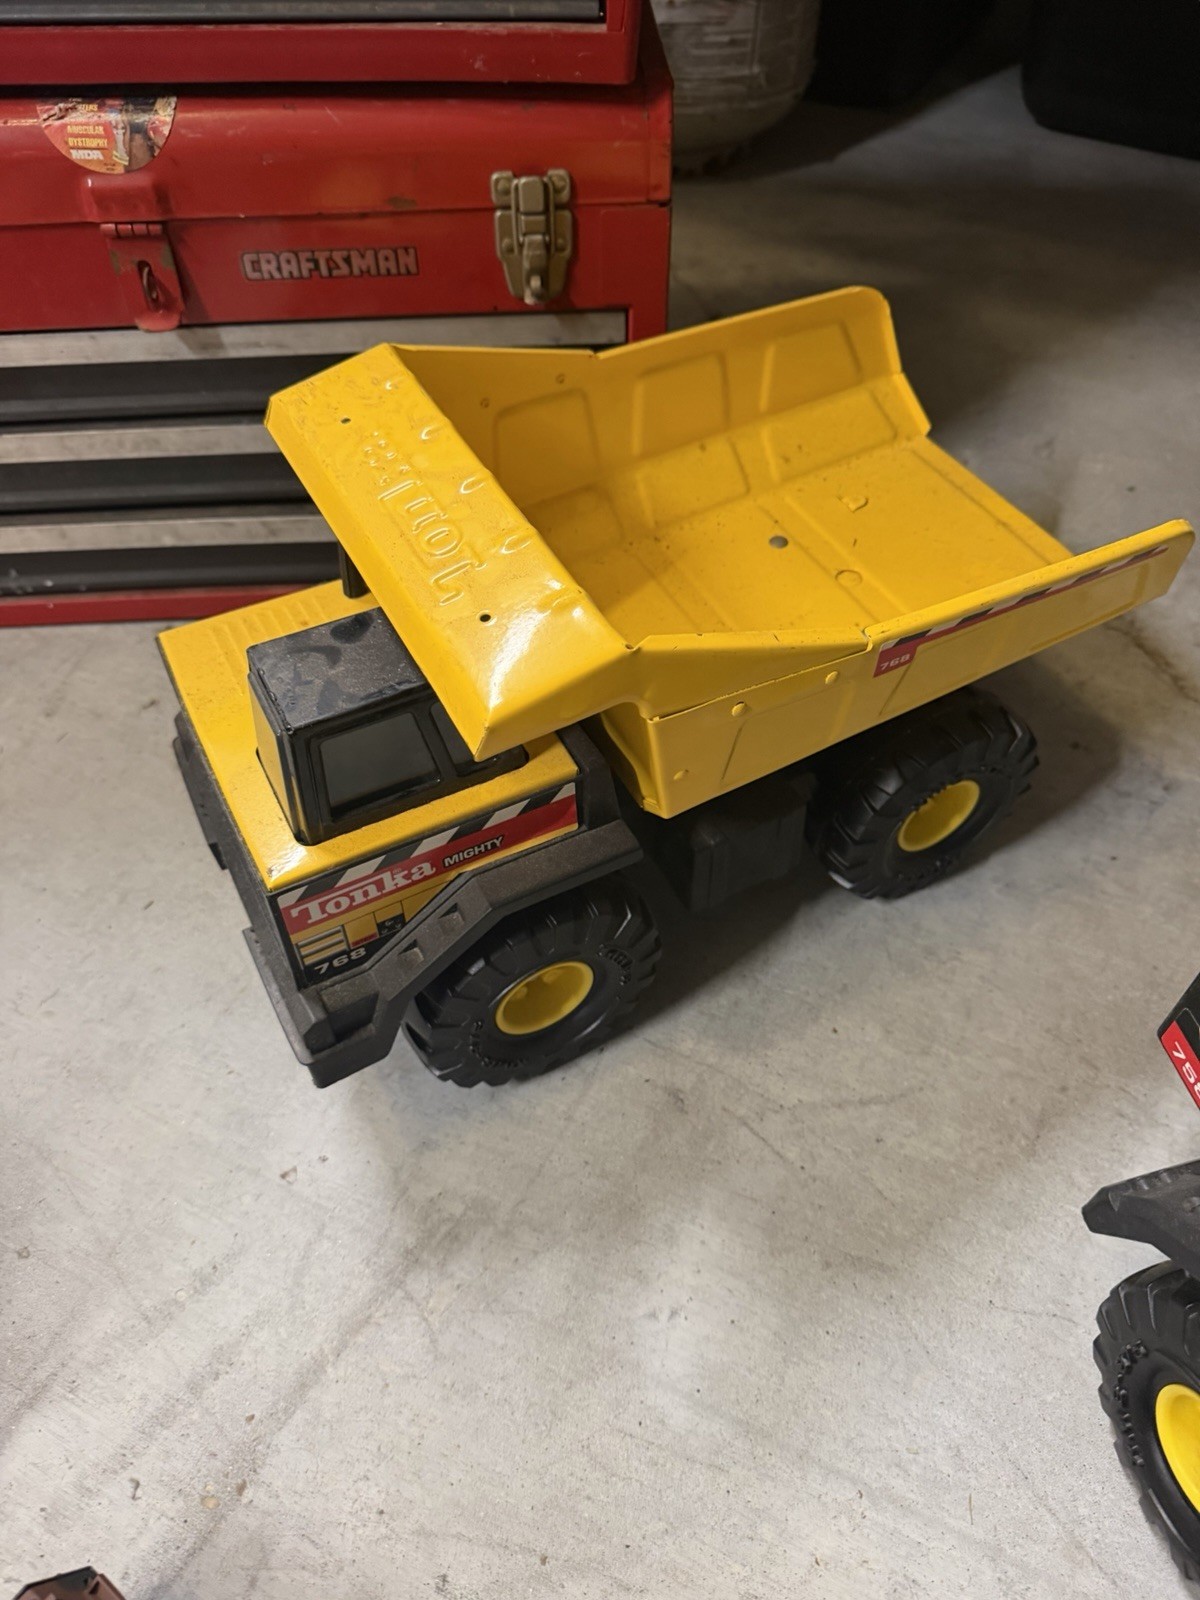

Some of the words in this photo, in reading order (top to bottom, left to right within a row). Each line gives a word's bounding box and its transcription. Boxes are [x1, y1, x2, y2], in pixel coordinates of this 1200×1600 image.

[67, 125, 105, 135] MUSCULAR
[68, 137, 108, 148] DYSTROPHY
[69, 149, 105, 160] MDA
[241, 247, 419, 281] CRAFTSMAN
[880, 653, 911, 671] 768
[290, 861, 437, 924] Tonka
[443, 836, 504, 868] MIGHTY
[313, 946, 367, 975] 768
